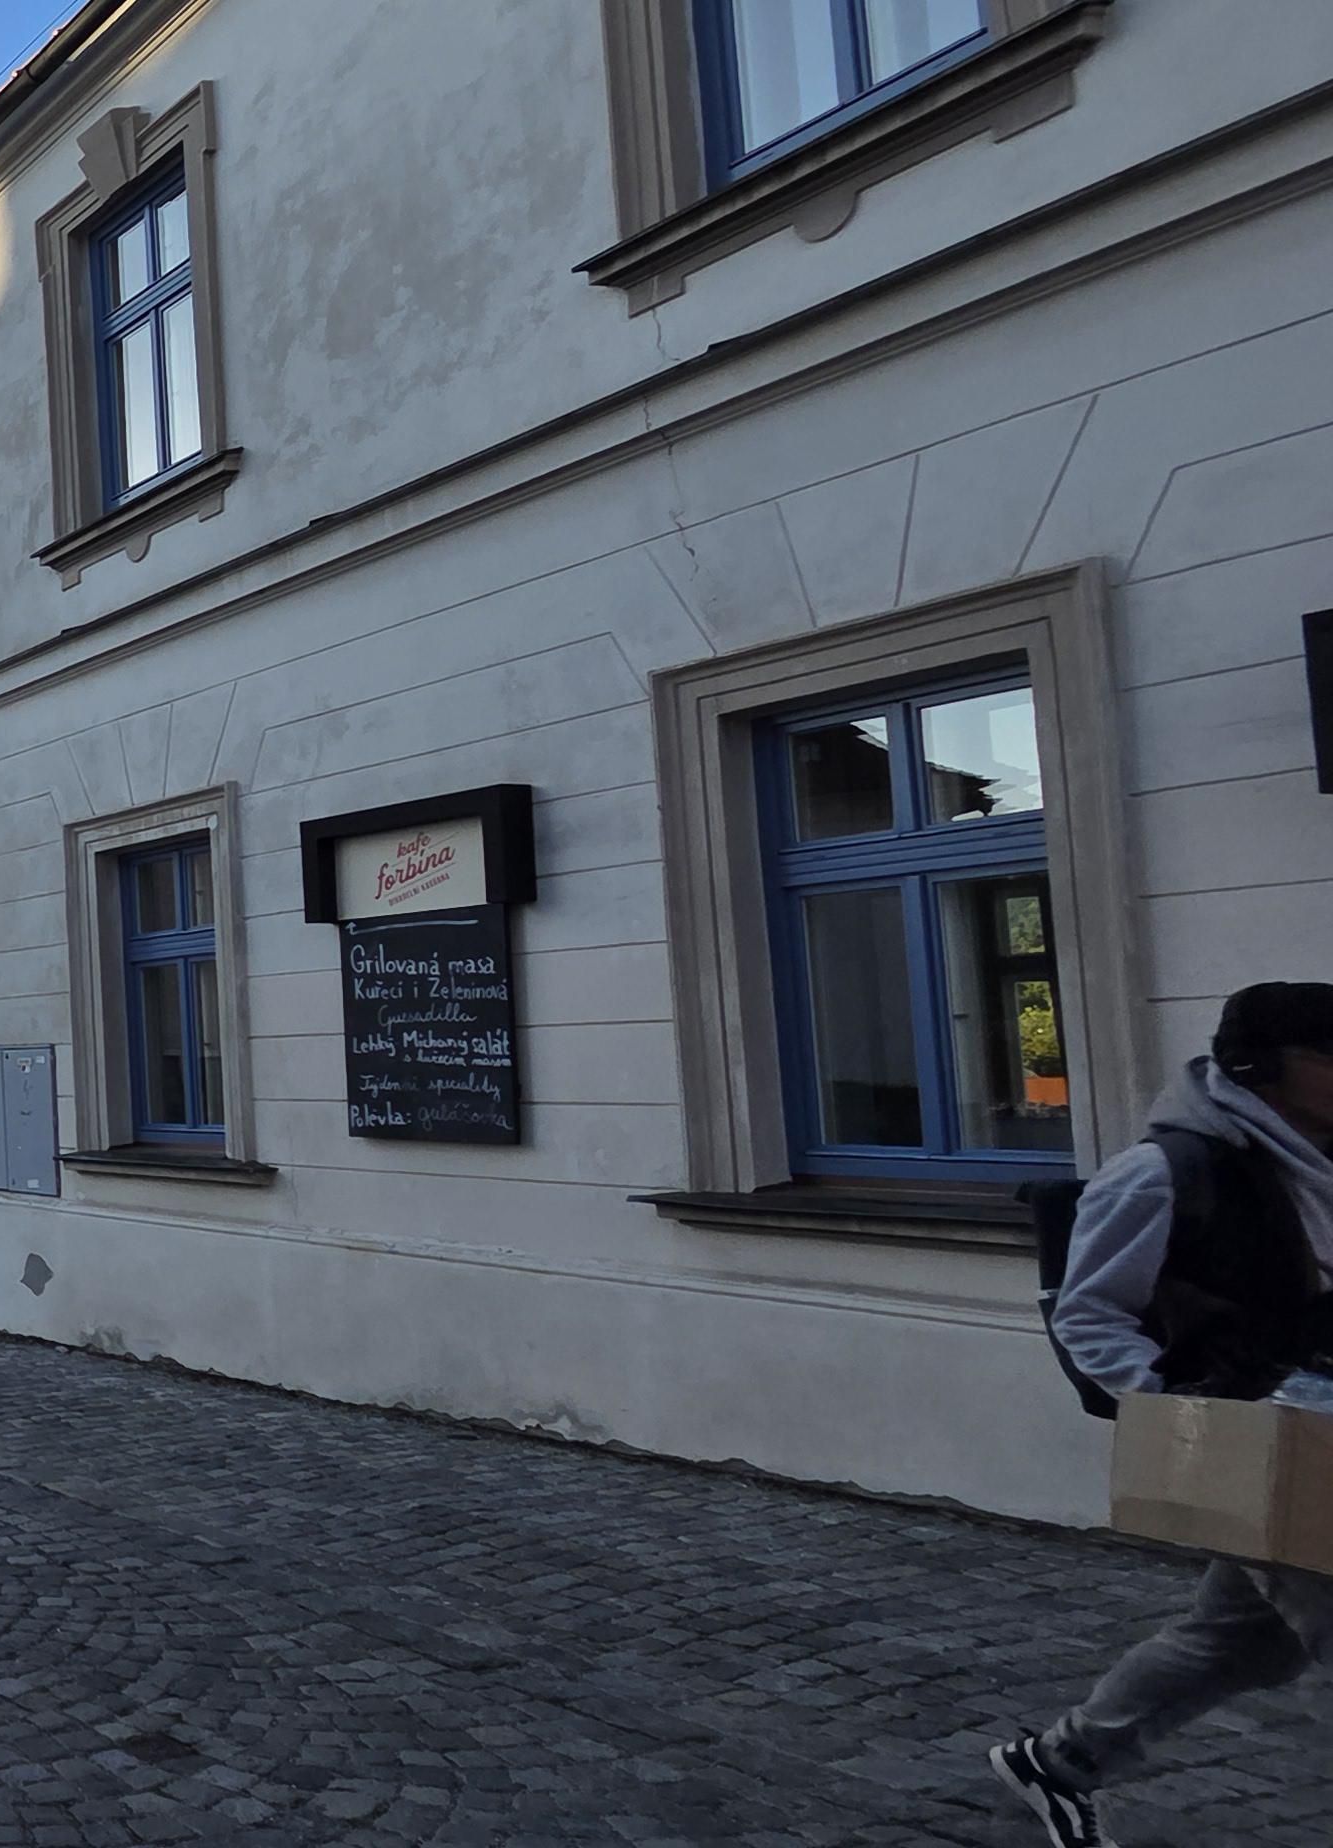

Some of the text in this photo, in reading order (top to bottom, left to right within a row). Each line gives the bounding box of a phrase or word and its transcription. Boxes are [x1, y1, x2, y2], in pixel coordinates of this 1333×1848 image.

[397, 831, 432, 858] kafe
[350, 944, 496, 976] Grilovaná masa
[353, 977, 509, 1001] Kuřecí i Zeleninová
[471, 1028, 511, 1056] salát
